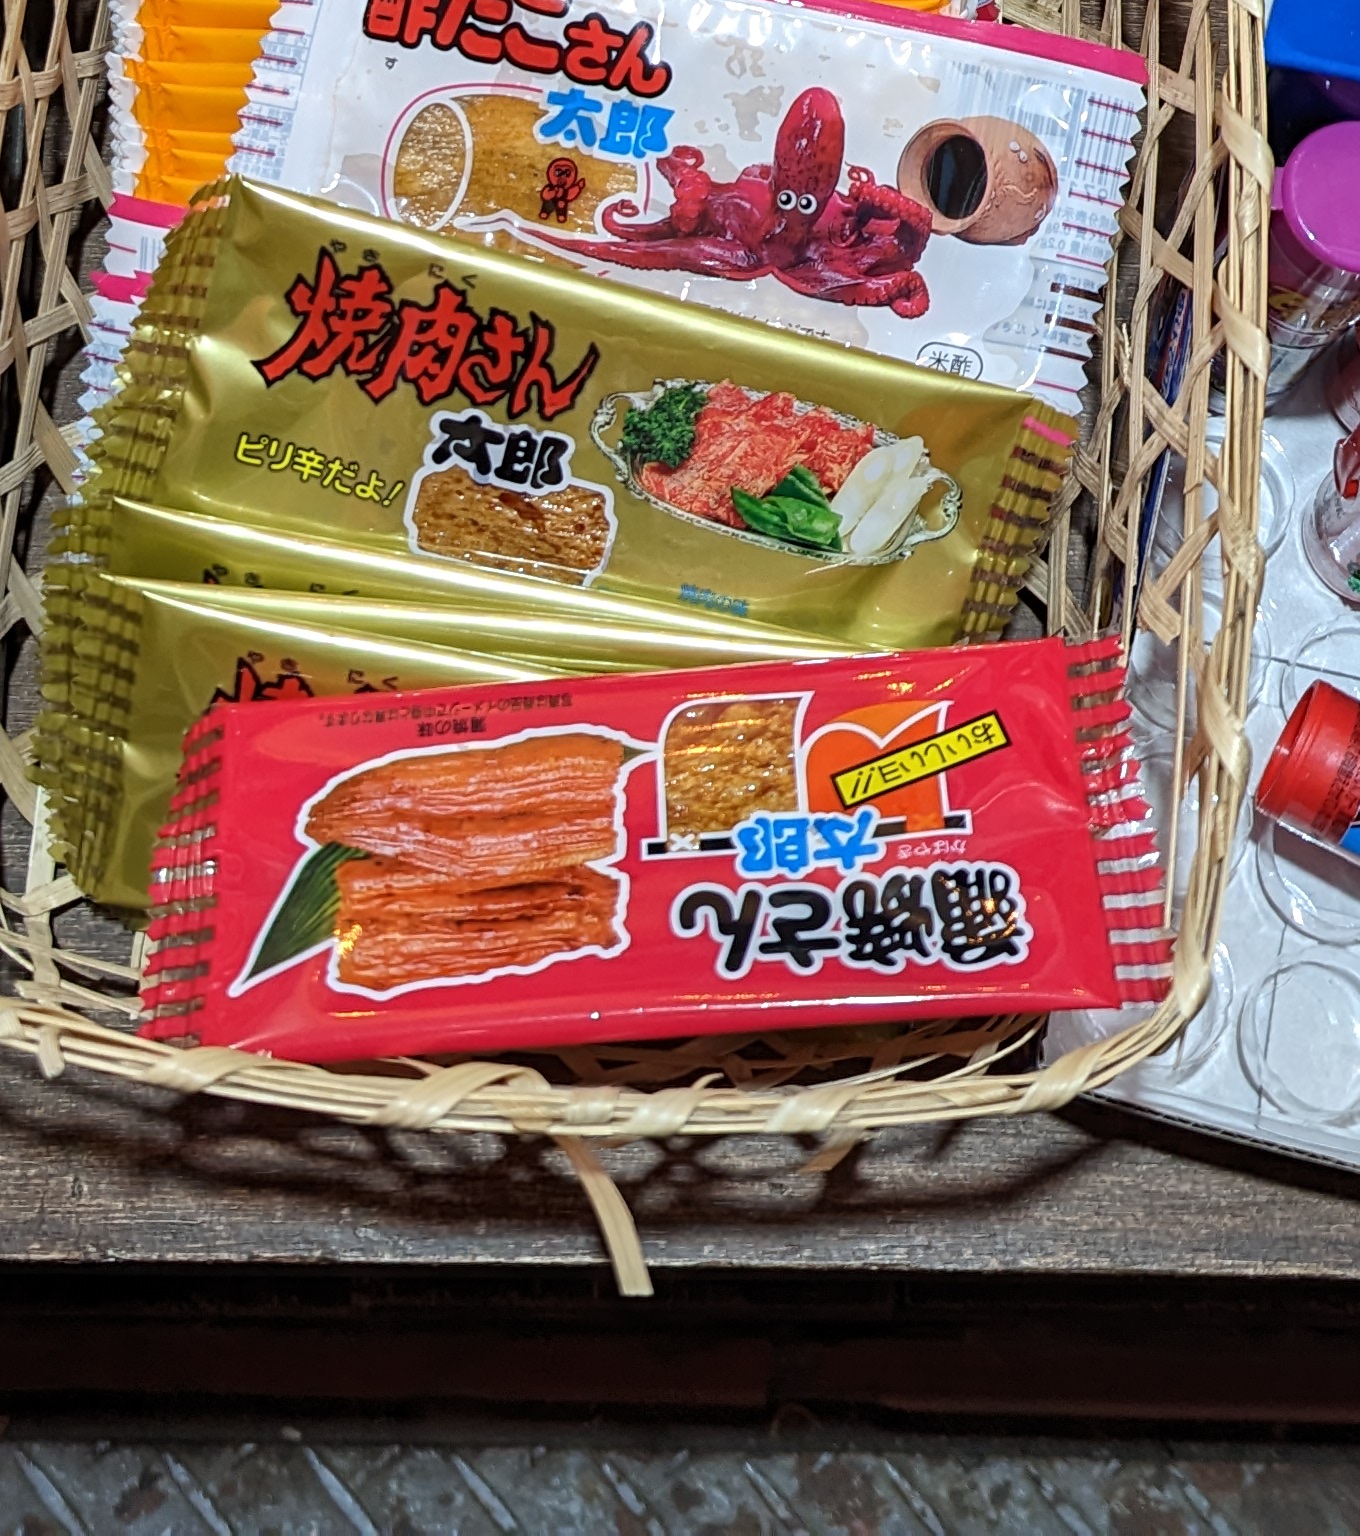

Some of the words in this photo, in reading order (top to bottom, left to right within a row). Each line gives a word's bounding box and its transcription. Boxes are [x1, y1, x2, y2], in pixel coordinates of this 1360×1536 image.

[536, 87, 676, 159] 太郎
[259, 246, 598, 419] 焼肉さん
[234, 433, 403, 510] ピリ辛だよ!
[432, 413, 569, 490] 太郎
[734, 810, 881, 874] 太郎
[676, 867, 1025, 974] 蒲焼さん
